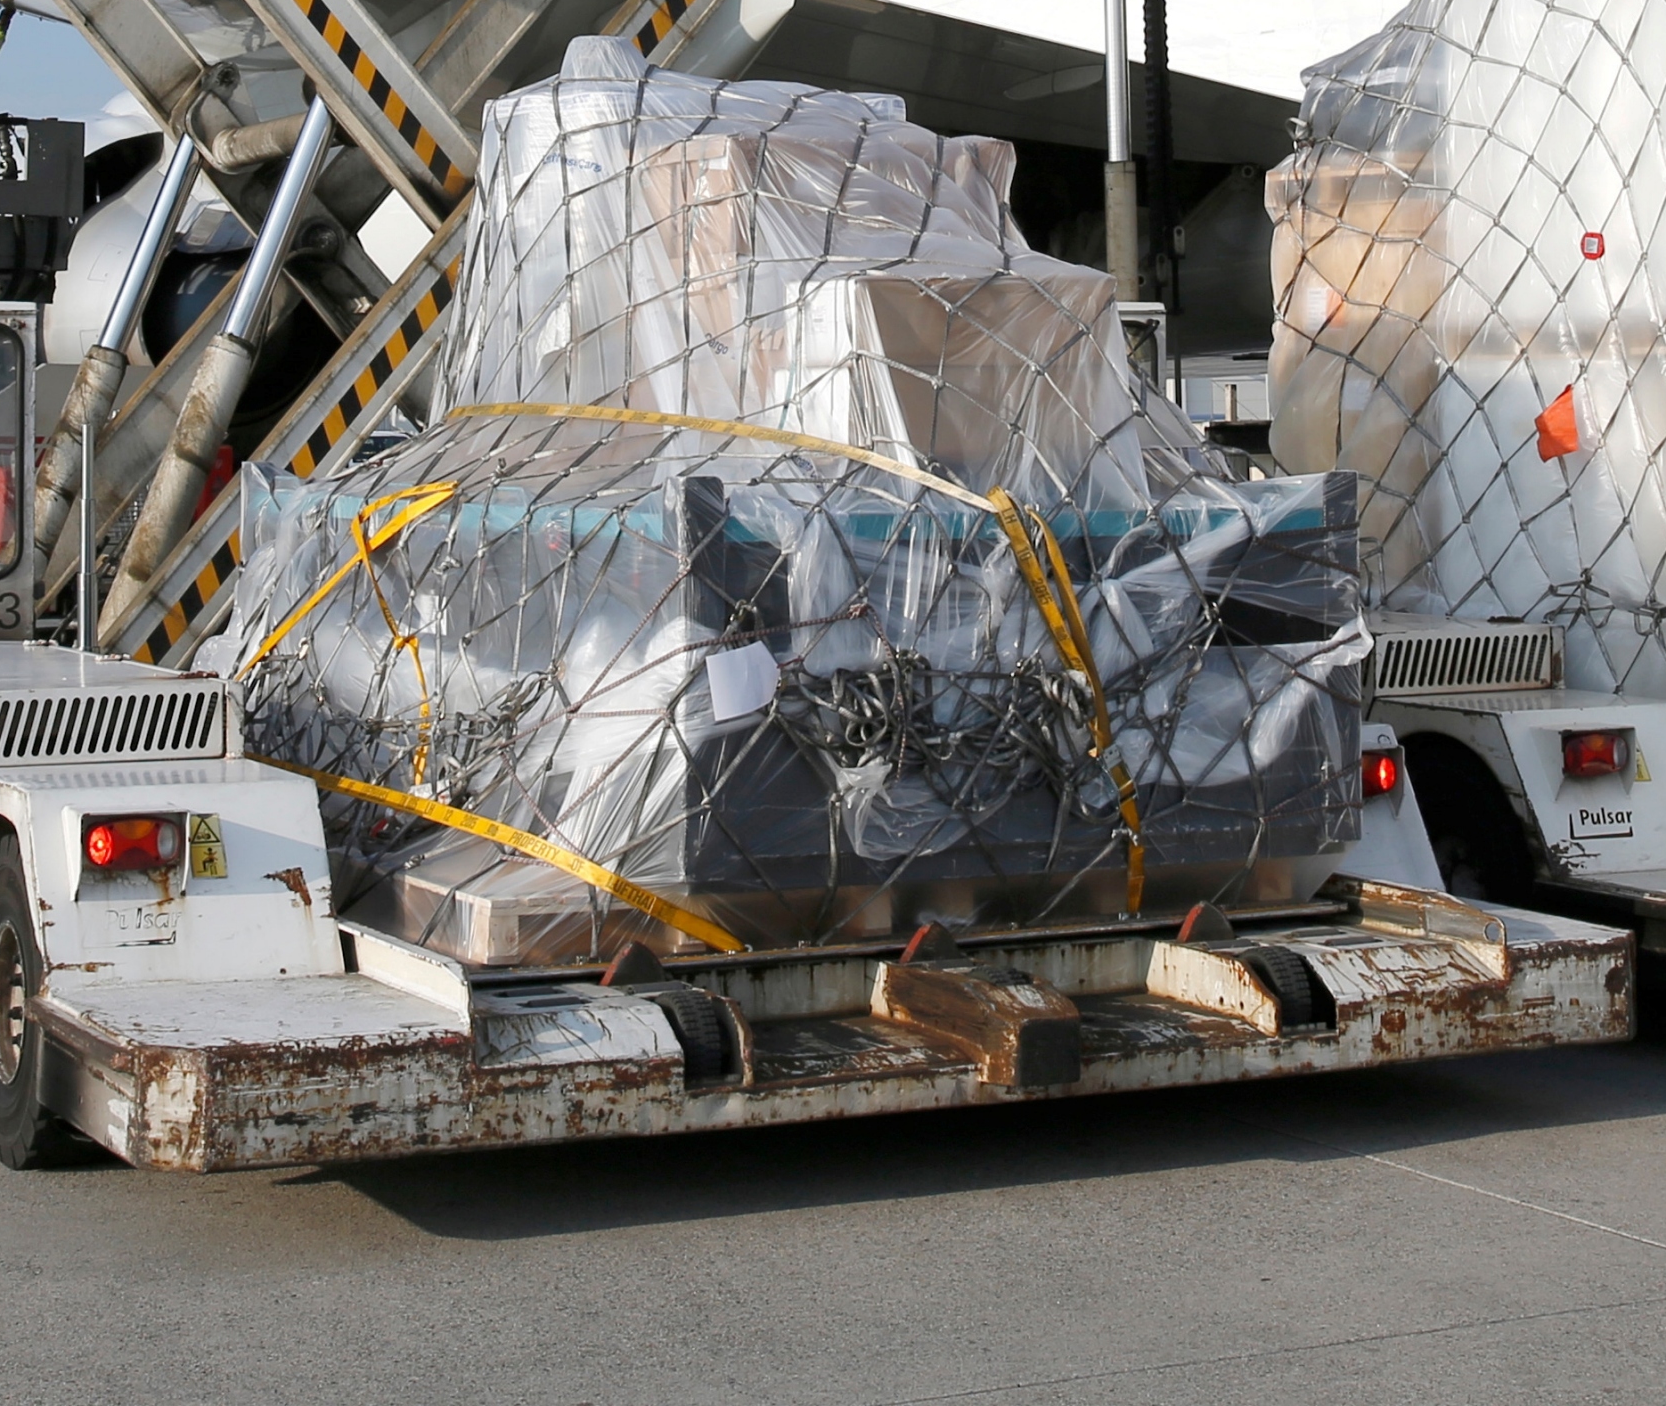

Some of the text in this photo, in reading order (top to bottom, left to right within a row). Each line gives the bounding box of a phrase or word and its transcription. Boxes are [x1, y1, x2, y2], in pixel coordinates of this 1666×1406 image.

[1031, 577, 1054, 606] 2015
[1579, 807, 1632, 825] Pulsar
[508, 830, 559, 860] PROPERTY
[570, 858, 584, 874] OF
[106, 908, 181, 930] Pulsar
